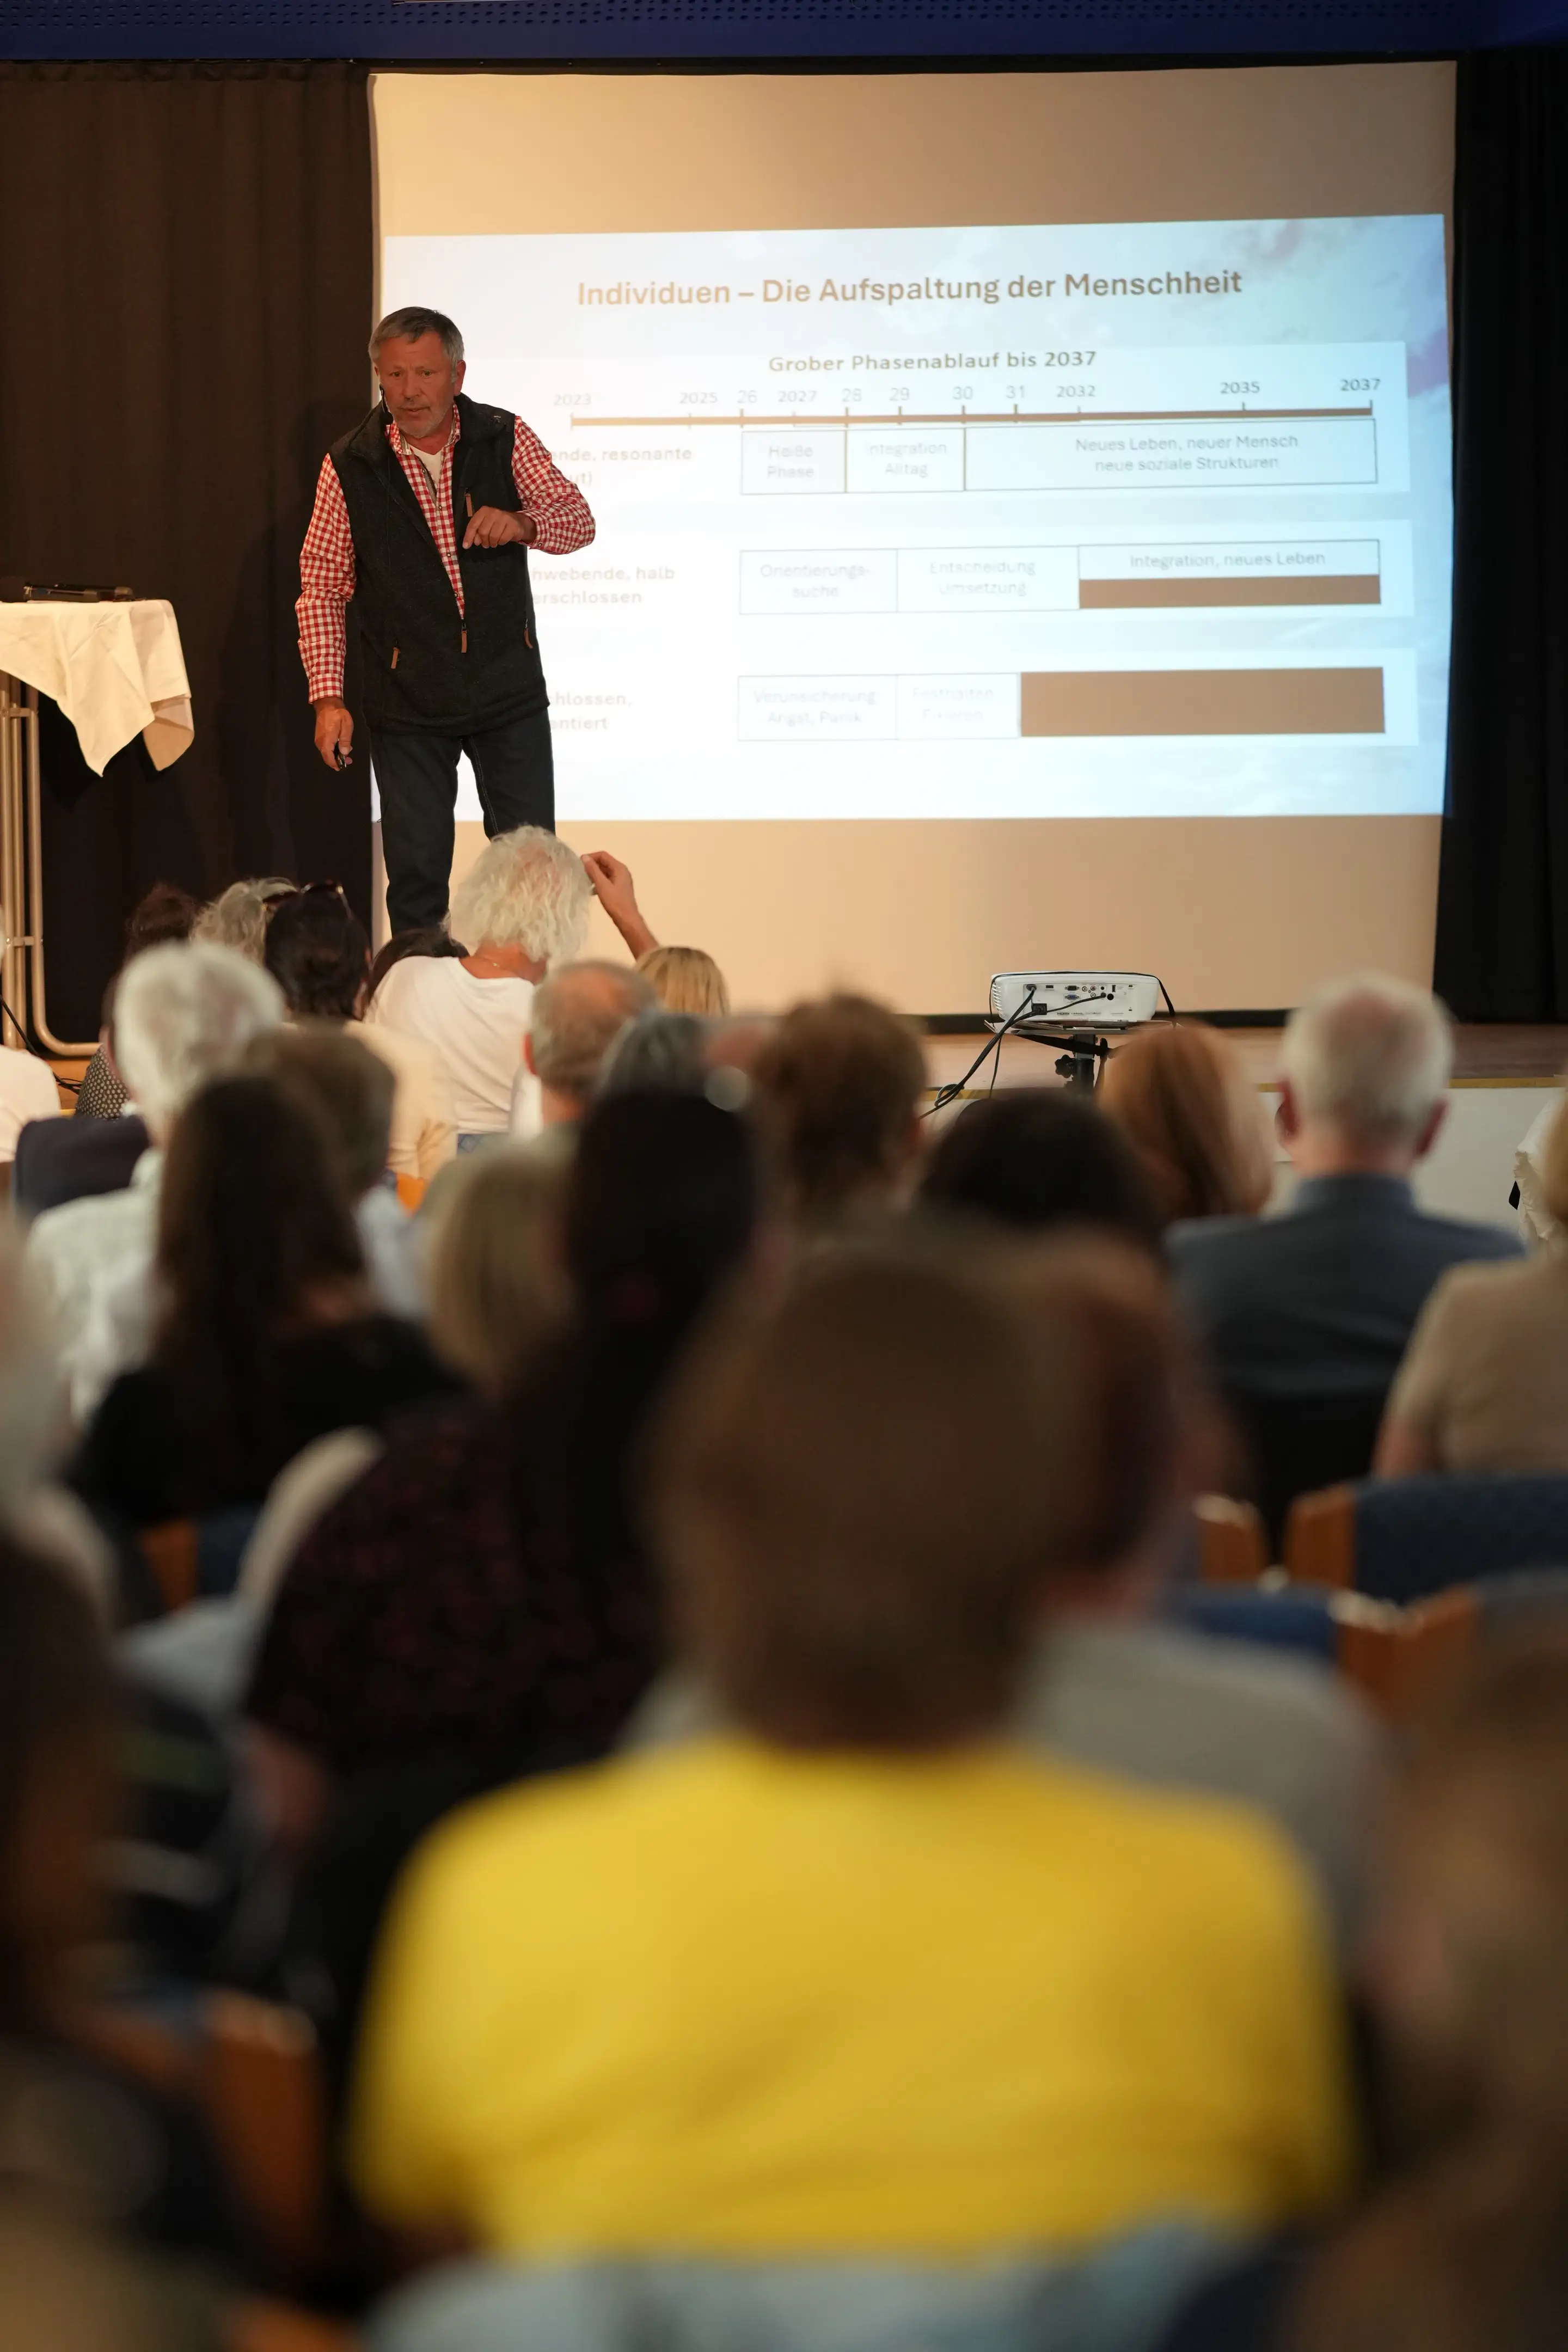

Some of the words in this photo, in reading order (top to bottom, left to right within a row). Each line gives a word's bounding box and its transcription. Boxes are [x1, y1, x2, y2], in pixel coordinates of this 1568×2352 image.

[578, 281, 731, 306] Individuen
[762, 279, 811, 303] Die
[819, 277, 1000, 306] Aufspaltung
[1008, 274, 1056, 298] der
[1065, 270, 1243, 296] Menschheit
[769, 356, 844, 372] Grober
[852, 351, 1000, 370] Phasenablauf
[1007, 351, 1037, 367] bis
[1044, 350, 1097, 367] 2037
[553, 393, 592, 407] 2023
[679, 391, 719, 405] 2025
[737, 389, 758, 405] 26
[778, 390, 817, 403] 2027
[841, 387, 862, 403] 28
[889, 387, 910, 402] 29
[952, 385, 973, 401] 30
[1006, 384, 1025, 400] 31
[1056, 384, 1096, 398] 2032
[1220, 381, 1261, 395] 2035
[1340, 377, 1382, 391] 2037
[867, 440, 949, 458] Integration
[1075, 439, 1126, 451] Neues
[1129, 438, 1183, 452] Leben,
[1187, 438, 1233, 450] neuer
[1236, 434, 1299, 448] Mensch
[552, 448, 596, 462] ende,
[602, 448, 693, 461] resonante
[767, 465, 814, 479] Phase
[885, 463, 929, 479] Alltag
[1095, 461, 1135, 472] neue
[1138, 457, 1193, 471] soziale
[1196, 457, 1280, 470] Strukturen
[1130, 554, 1221, 571] Integration,
[1224, 554, 1273, 566] neues
[1276, 552, 1326, 566] Leben
[531, 567, 632, 581] hwebende,
[635, 566, 676, 580] halb
[533, 590, 642, 604] erschlossen
[792, 585, 840, 598] suche
[940, 581, 1028, 598] Umsetzung
[550, 716, 608, 730] entiert
